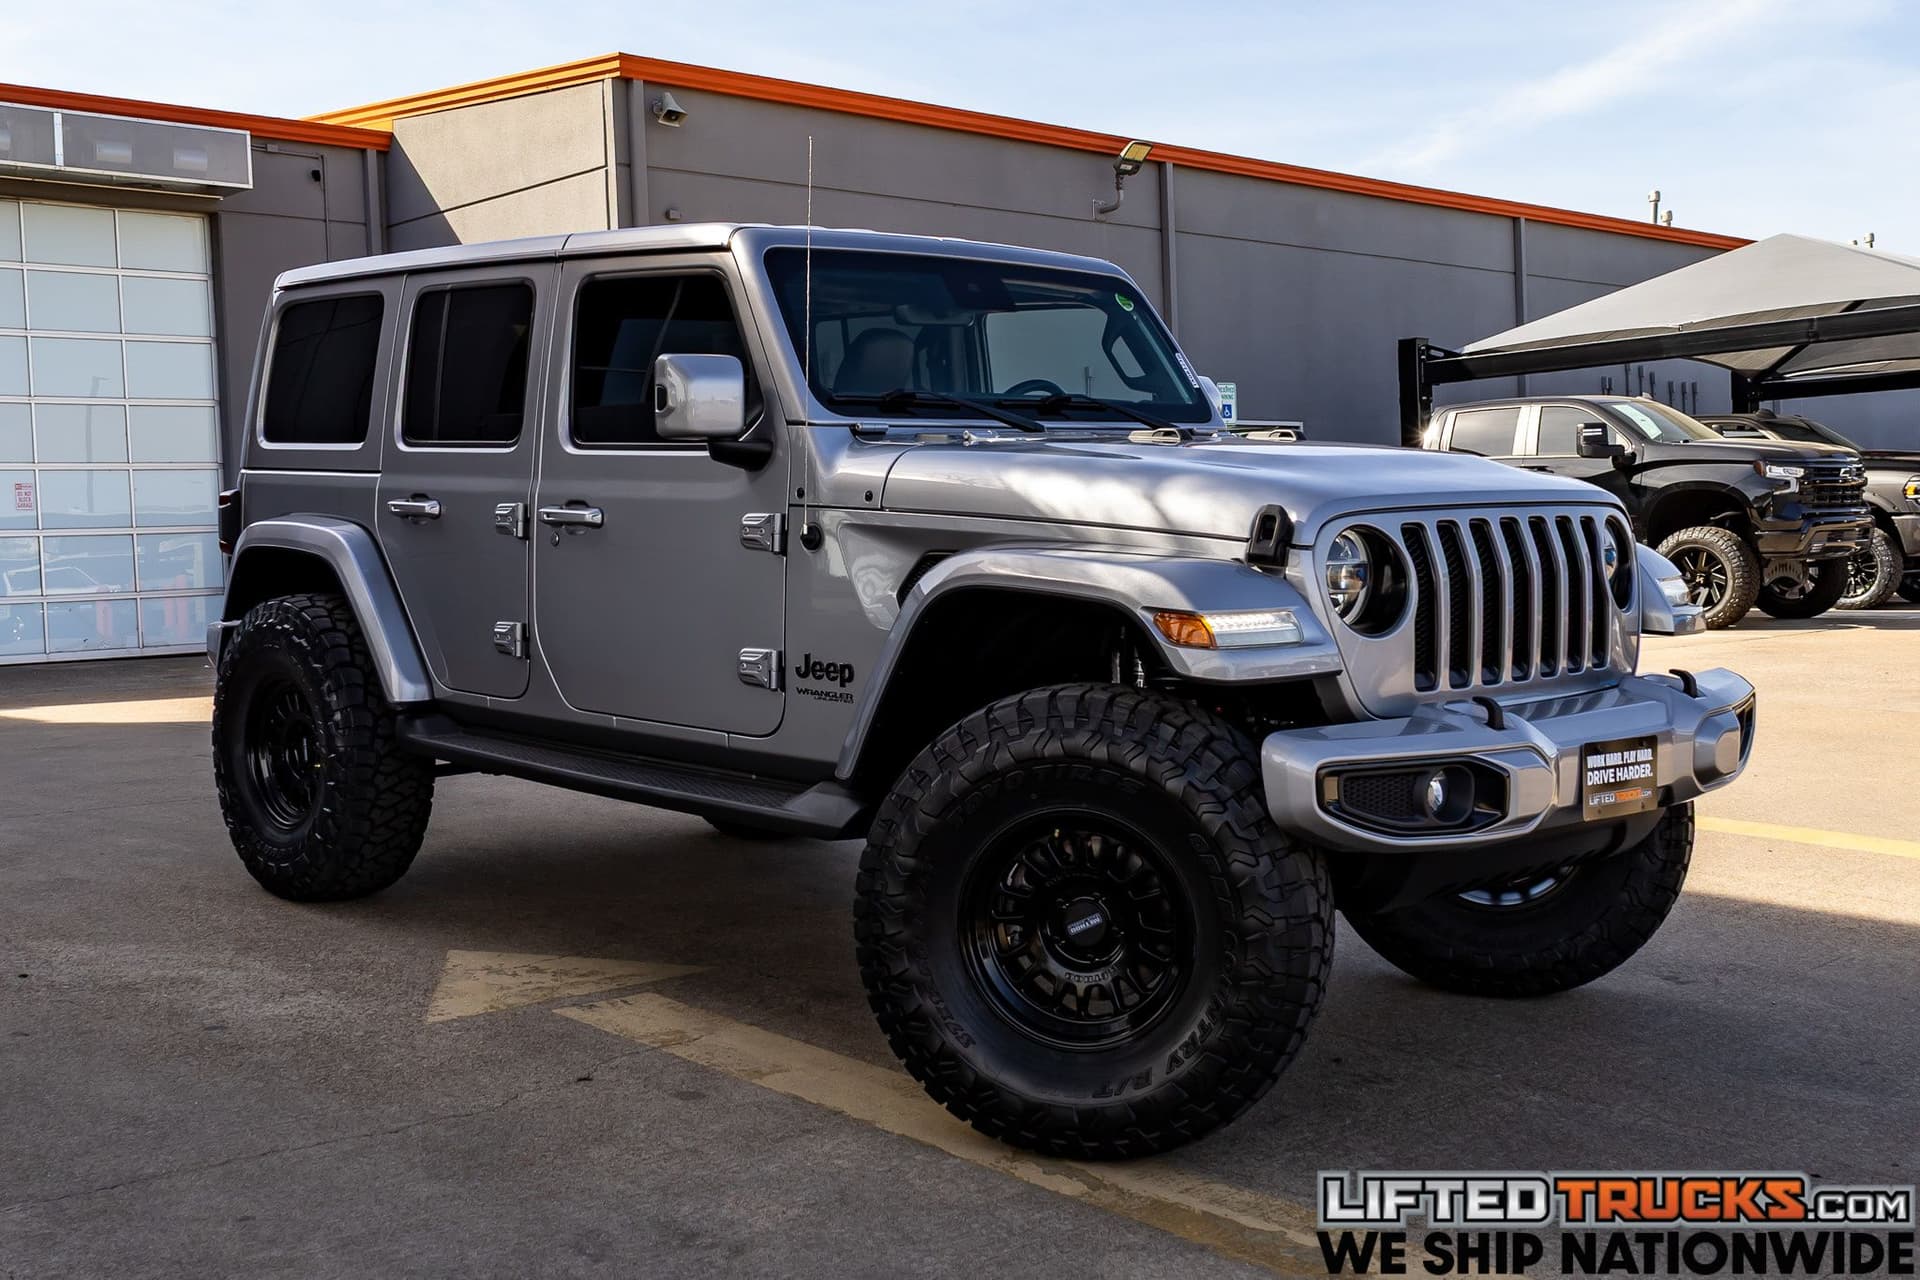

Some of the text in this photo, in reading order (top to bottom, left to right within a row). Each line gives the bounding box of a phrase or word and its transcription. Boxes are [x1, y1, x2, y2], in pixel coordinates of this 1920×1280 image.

[795, 653, 855, 688] Jeep
[796, 687, 854, 700] WRANGLER
[1587, 763, 1653, 786] DRIVE HARDER.
